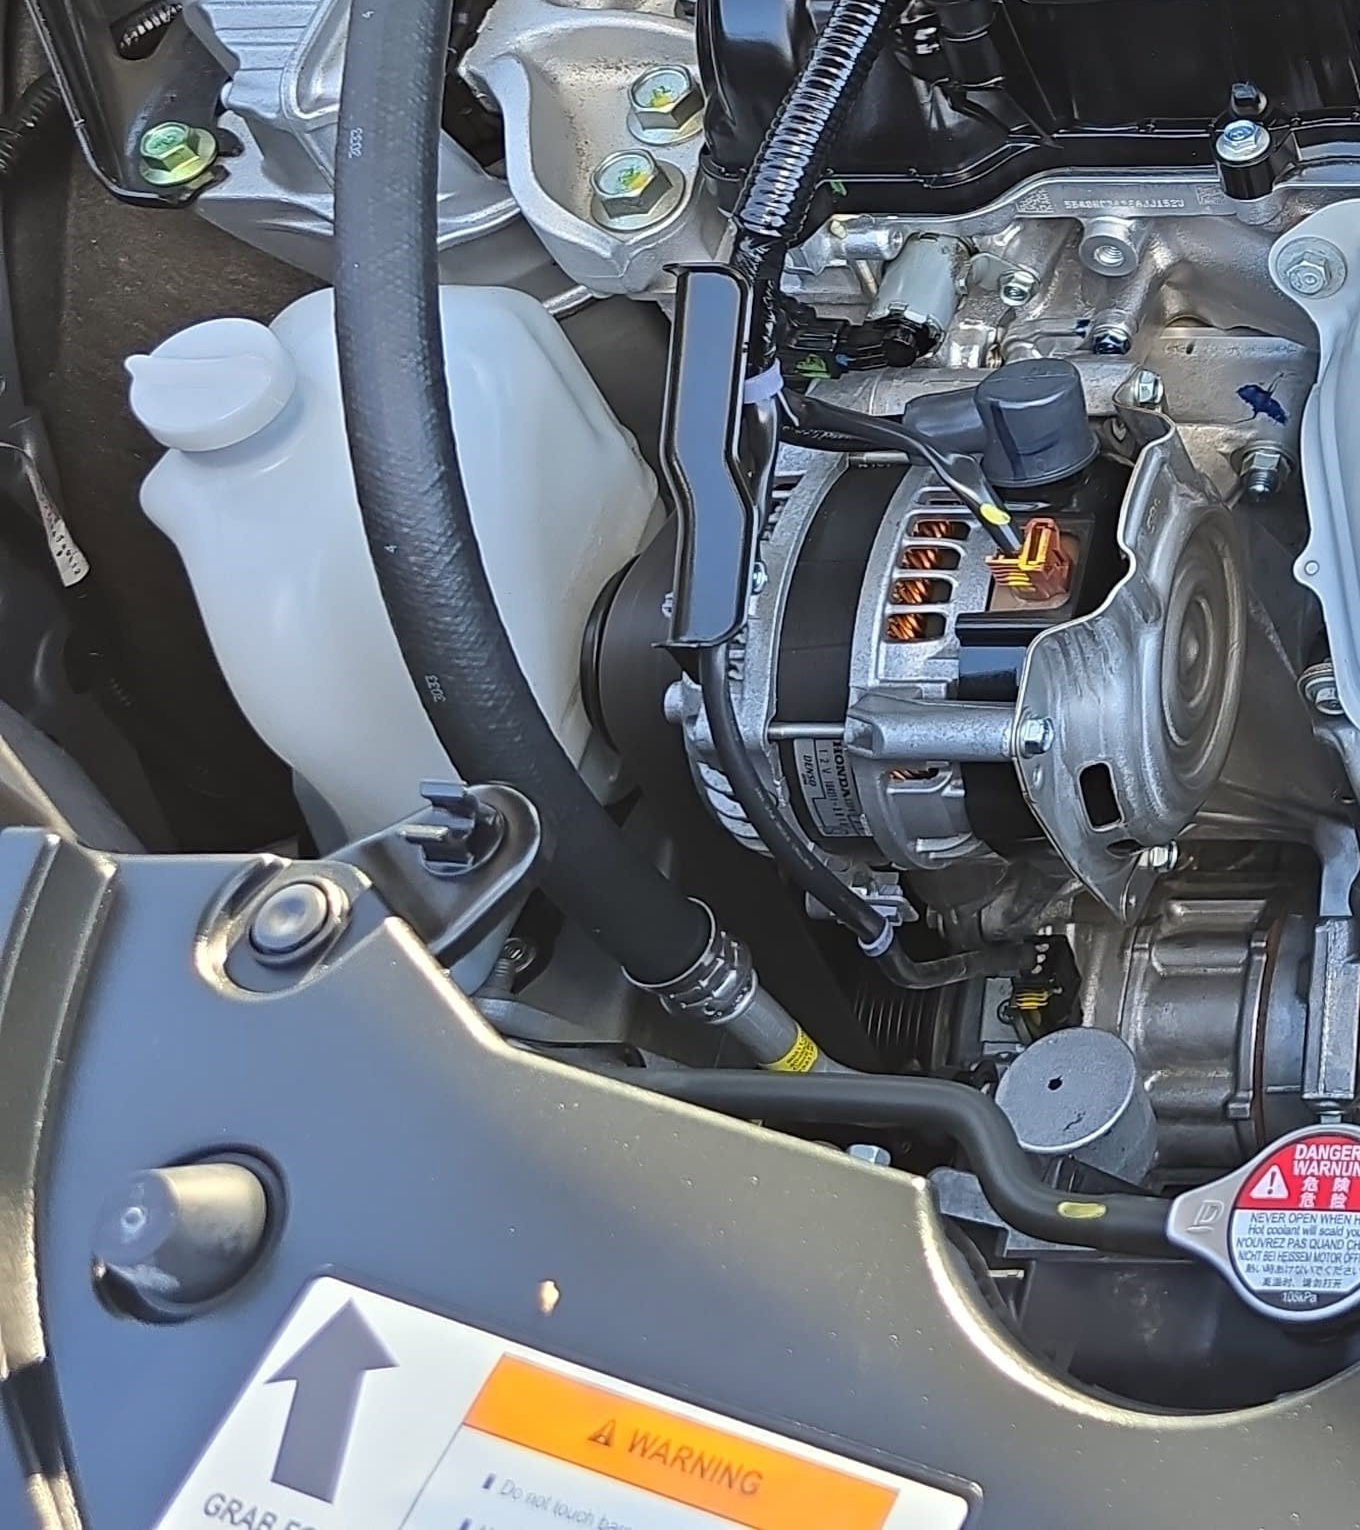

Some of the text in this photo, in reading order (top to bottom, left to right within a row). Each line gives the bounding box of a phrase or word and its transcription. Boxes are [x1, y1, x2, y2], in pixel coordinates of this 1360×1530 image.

[803, 754, 817, 787] DENSO
[832, 741, 851, 798] HONDA
[1248, 1225, 1265, 1236] Hot
[1266, 1225, 1300, 1236] coolant
[1302, 1225, 1317, 1236] will
[1250, 1212, 1286, 1224] NEVER
[1288, 1213, 1317, 1224] OPEN
[1320, 1214, 1352, 1225] WHEN
[1239, 1251, 1262, 1262] NICHT
[1262, 1251, 1276, 1262] BEI
[1277, 1251, 1312, 1263] HEISSEM
[1313, 1252, 1344, 1263] MOTOR
[1287, 1238, 1308, 1250] PAS
[1309, 1238, 1345, 1251] QUAND
[627, 1427, 765, 1498] WARNING
[203, 1491, 278, 1530] GRAB
[499, 1478, 524, 1501] Do
[525, 1491, 553, 1511] not
[553, 1499, 596, 1526] touch
